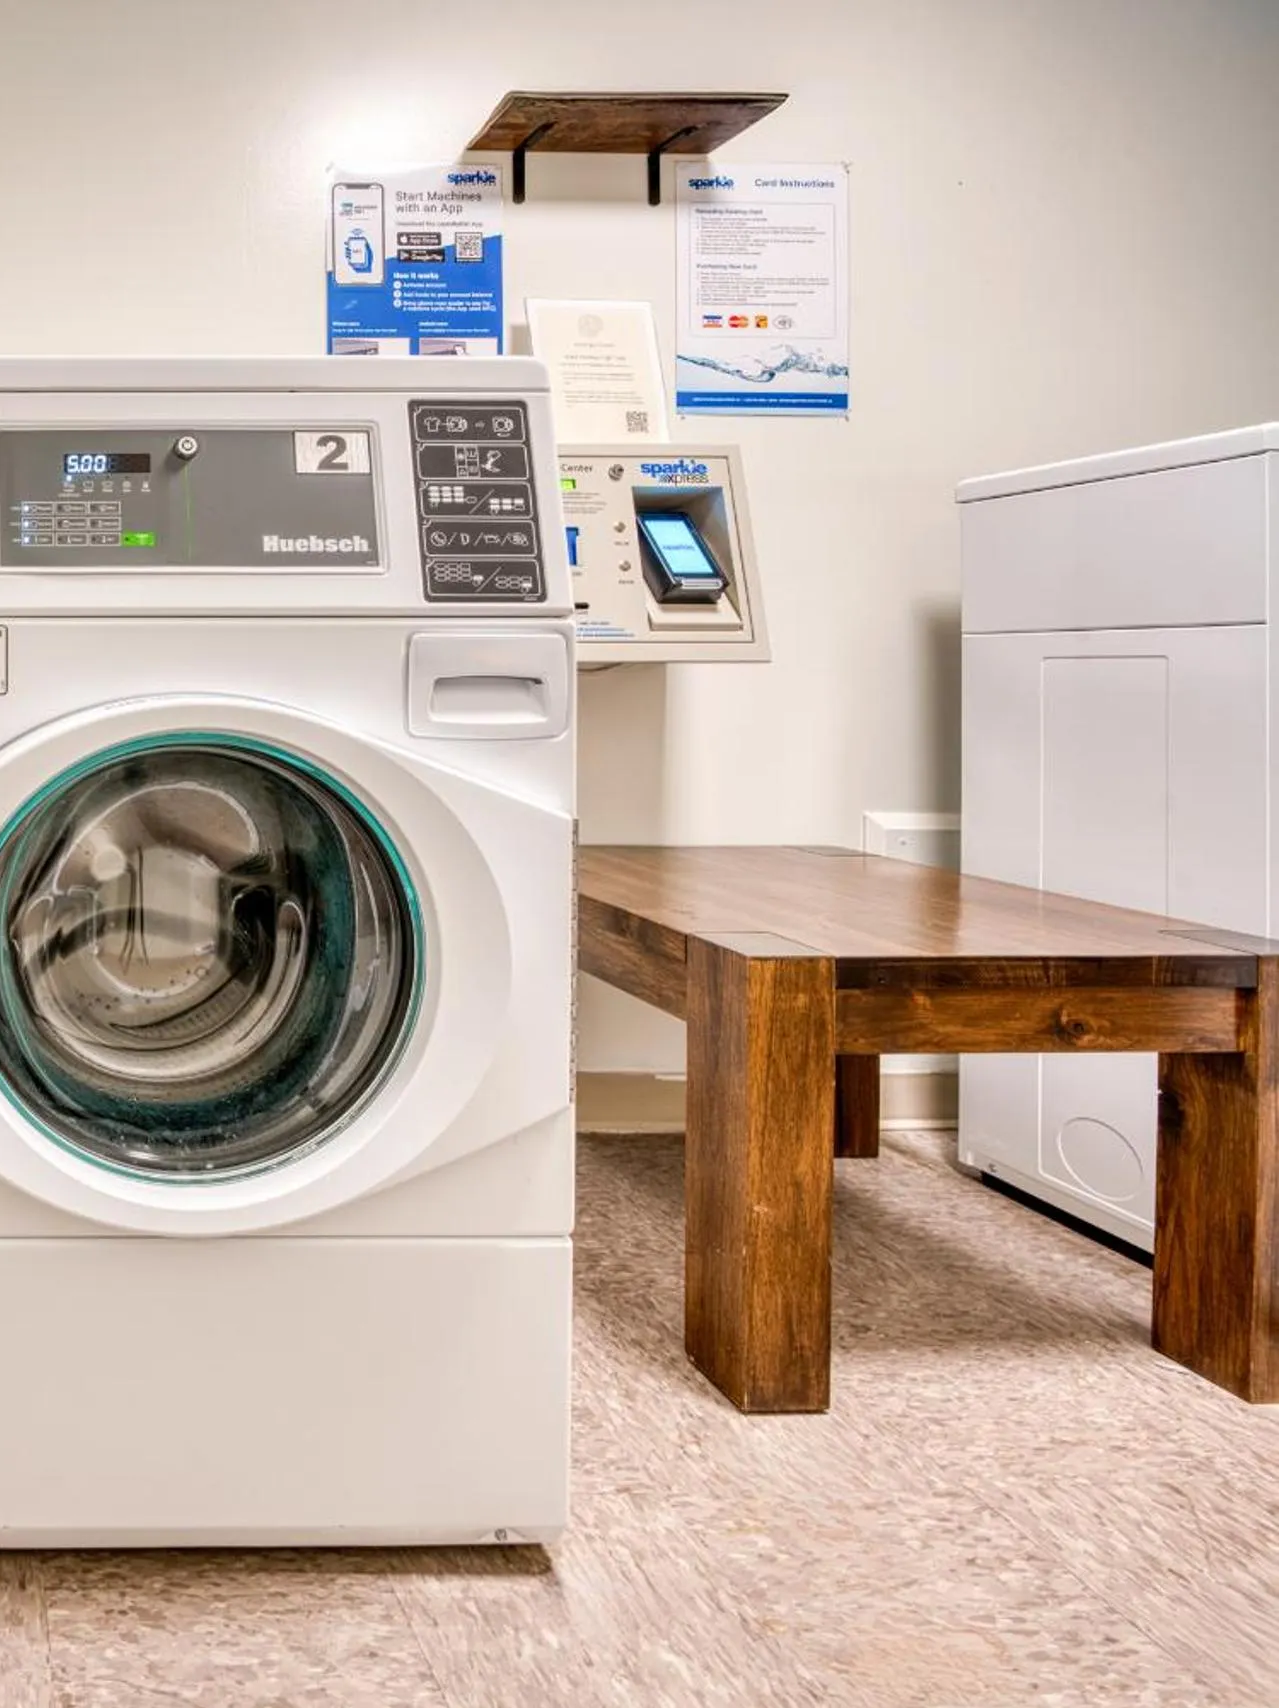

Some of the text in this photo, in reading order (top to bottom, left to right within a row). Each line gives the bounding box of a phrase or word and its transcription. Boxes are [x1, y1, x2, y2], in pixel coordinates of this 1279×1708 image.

[755, 178, 835, 189] Card Instructions
[395, 189, 482, 201] Start Machines
[396, 203, 463, 214] with an App
[316, 434, 349, 471] 2
[262, 535, 369, 552] Huebsch
